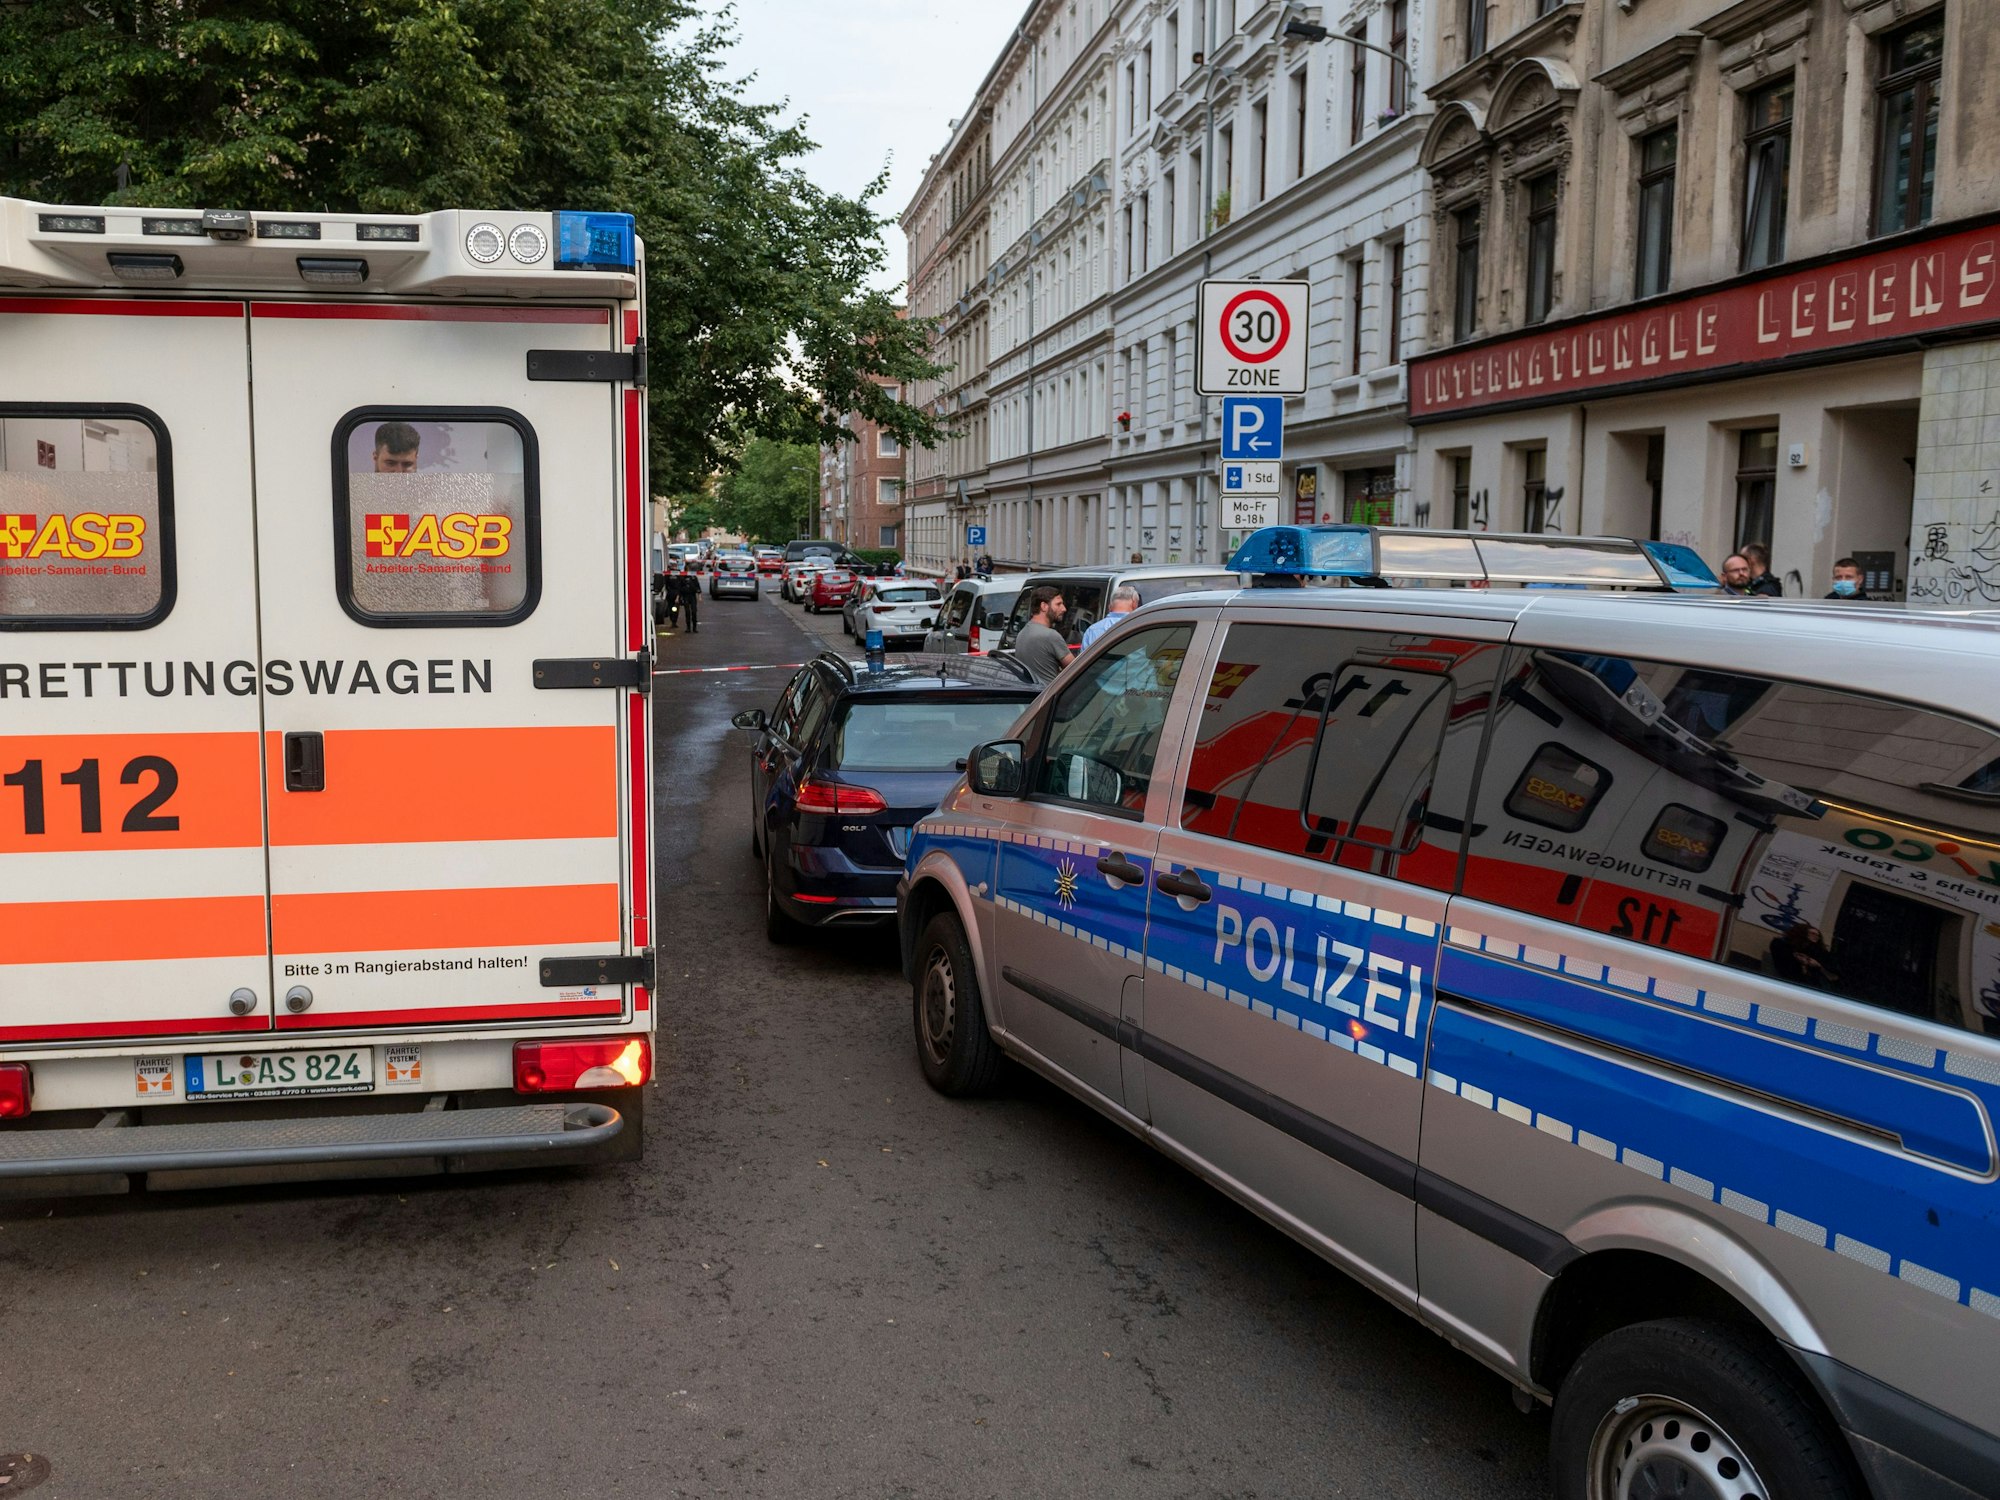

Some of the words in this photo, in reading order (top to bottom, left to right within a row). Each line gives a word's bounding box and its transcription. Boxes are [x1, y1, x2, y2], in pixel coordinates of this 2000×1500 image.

[1234, 310, 1275, 343] 30
[1424, 304, 1718, 405] INTERNATIONALE
[1227, 368, 1280, 386] ZONE
[1232, 404, 1265, 451] P
[1790, 453, 1802, 465] 92
[1255, 472, 1276, 483] Std.
[1233, 501, 1267, 511] Mo-Fr
[26, 512, 147, 560] ASB
[399, 512, 513, 559] ASB
[970, 527, 981, 543] P
[0, 565, 146, 576] rbeiter-Samariter-Bund
[366, 564, 511, 574] Arbeiter-Samariter-Bund
[0, 659, 493, 698] RETTUNGSWAGEN
[4, 755, 180, 835] 112
[284, 963, 319, 976] Bitte
[324, 963, 333, 974] 3
[336, 964, 349, 974] m
[354, 957, 473, 975] Rangierabstand
[478, 956, 528, 969] halten!
[1214, 903, 1422, 1039] POLIZEI
[386, 1046, 420, 1056] FAHRTEC
[389, 1055, 418, 1063] SYSTEME
[136, 1058, 171, 1067] FAHRTEC
[139, 1067, 169, 1075] SYSTEME
[305, 1053, 361, 1081] 824
